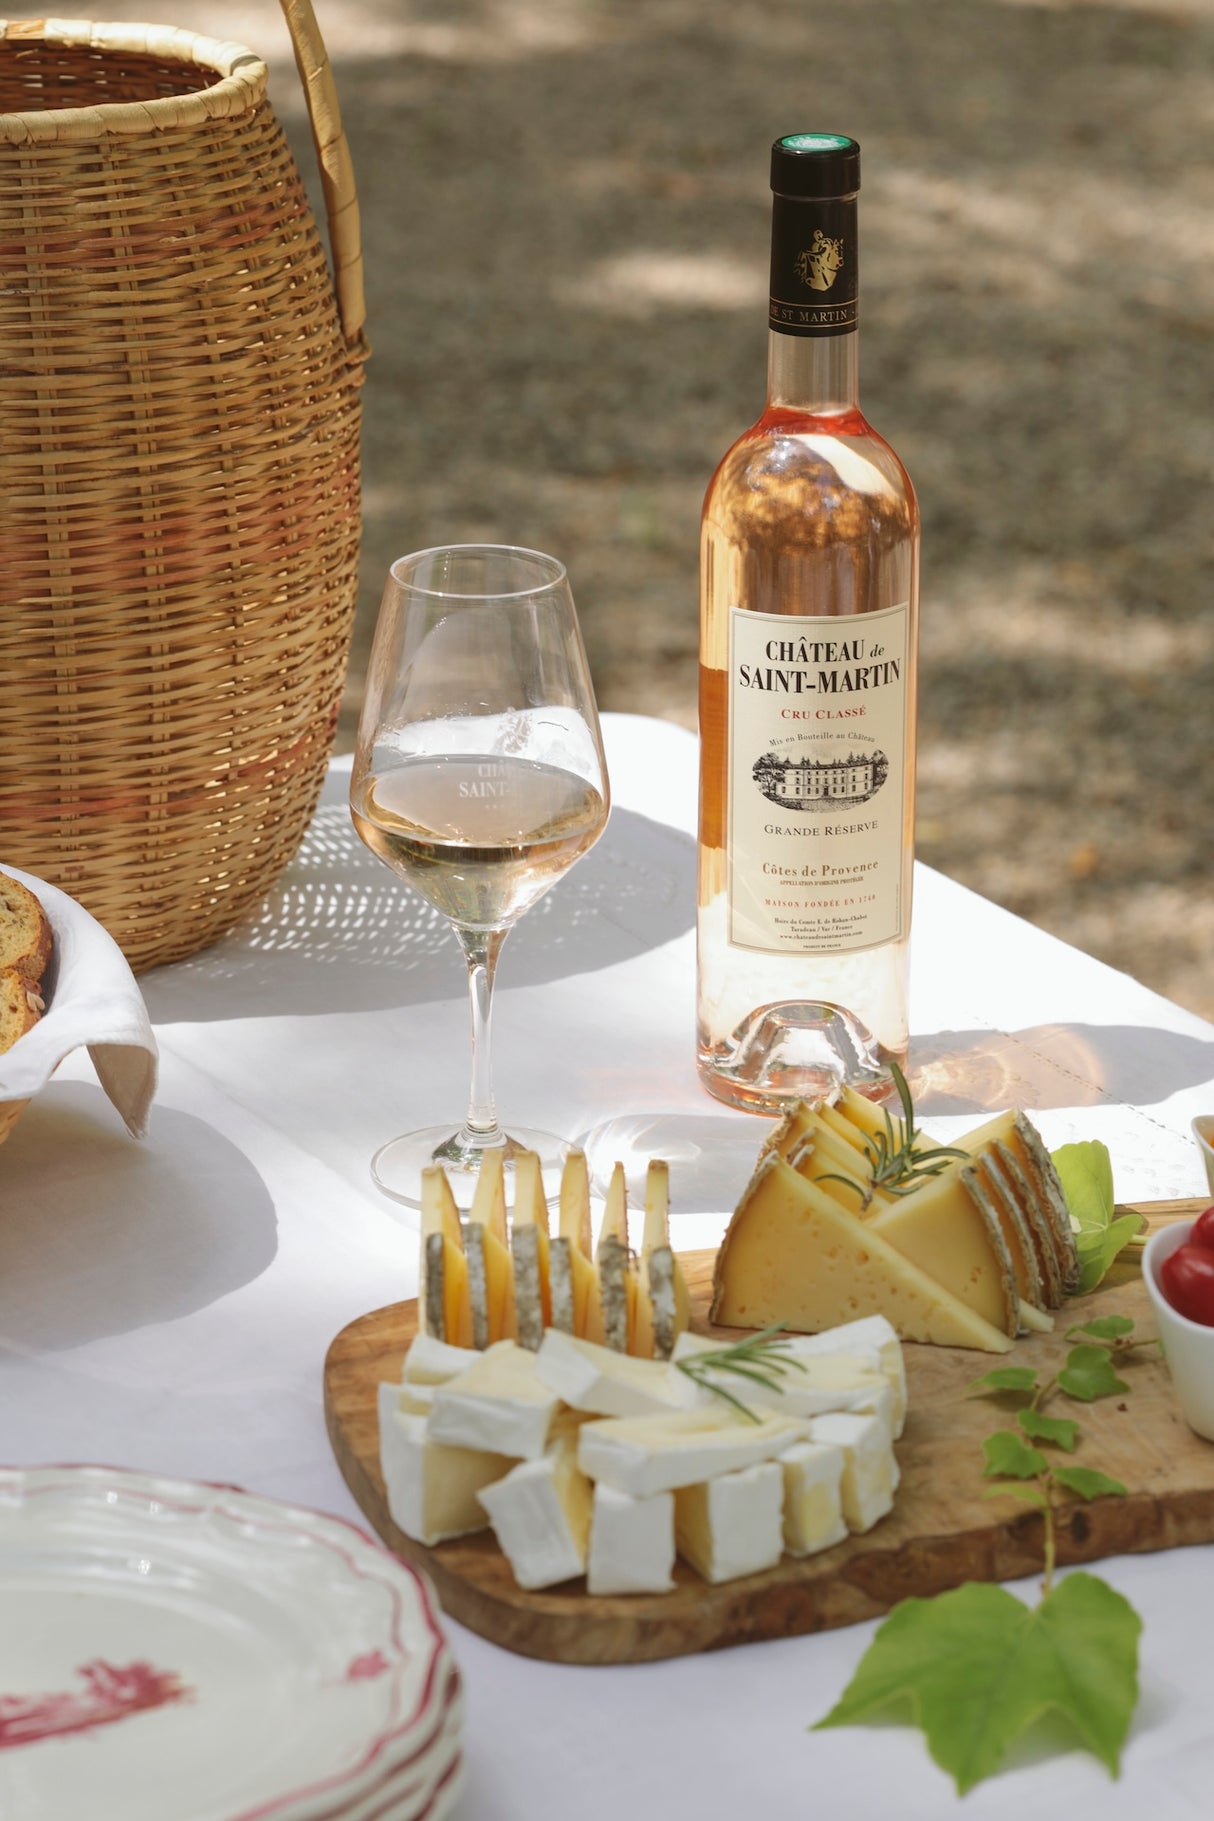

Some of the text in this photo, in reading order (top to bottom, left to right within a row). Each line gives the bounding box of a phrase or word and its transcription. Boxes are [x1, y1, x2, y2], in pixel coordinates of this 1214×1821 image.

[782, 309, 793, 320] ST
[800, 309, 848, 322] MARTIN
[765, 636, 885, 662] CHÂTEAU de
[739, 658, 901, 693] SAINT-MARTIN
[781, 705, 866, 720] CRU CLASSÉ
[769, 739, 783, 747] Mis
[797, 732, 833, 741] Bouteille
[848, 732, 875, 743] Château
[764, 820, 878, 836] GRANDE RÉSERVE
[762, 861, 879, 877] Côtes de Provence
[765, 898, 799, 908] MAISON
[804, 898, 840, 908] FONDÉE
